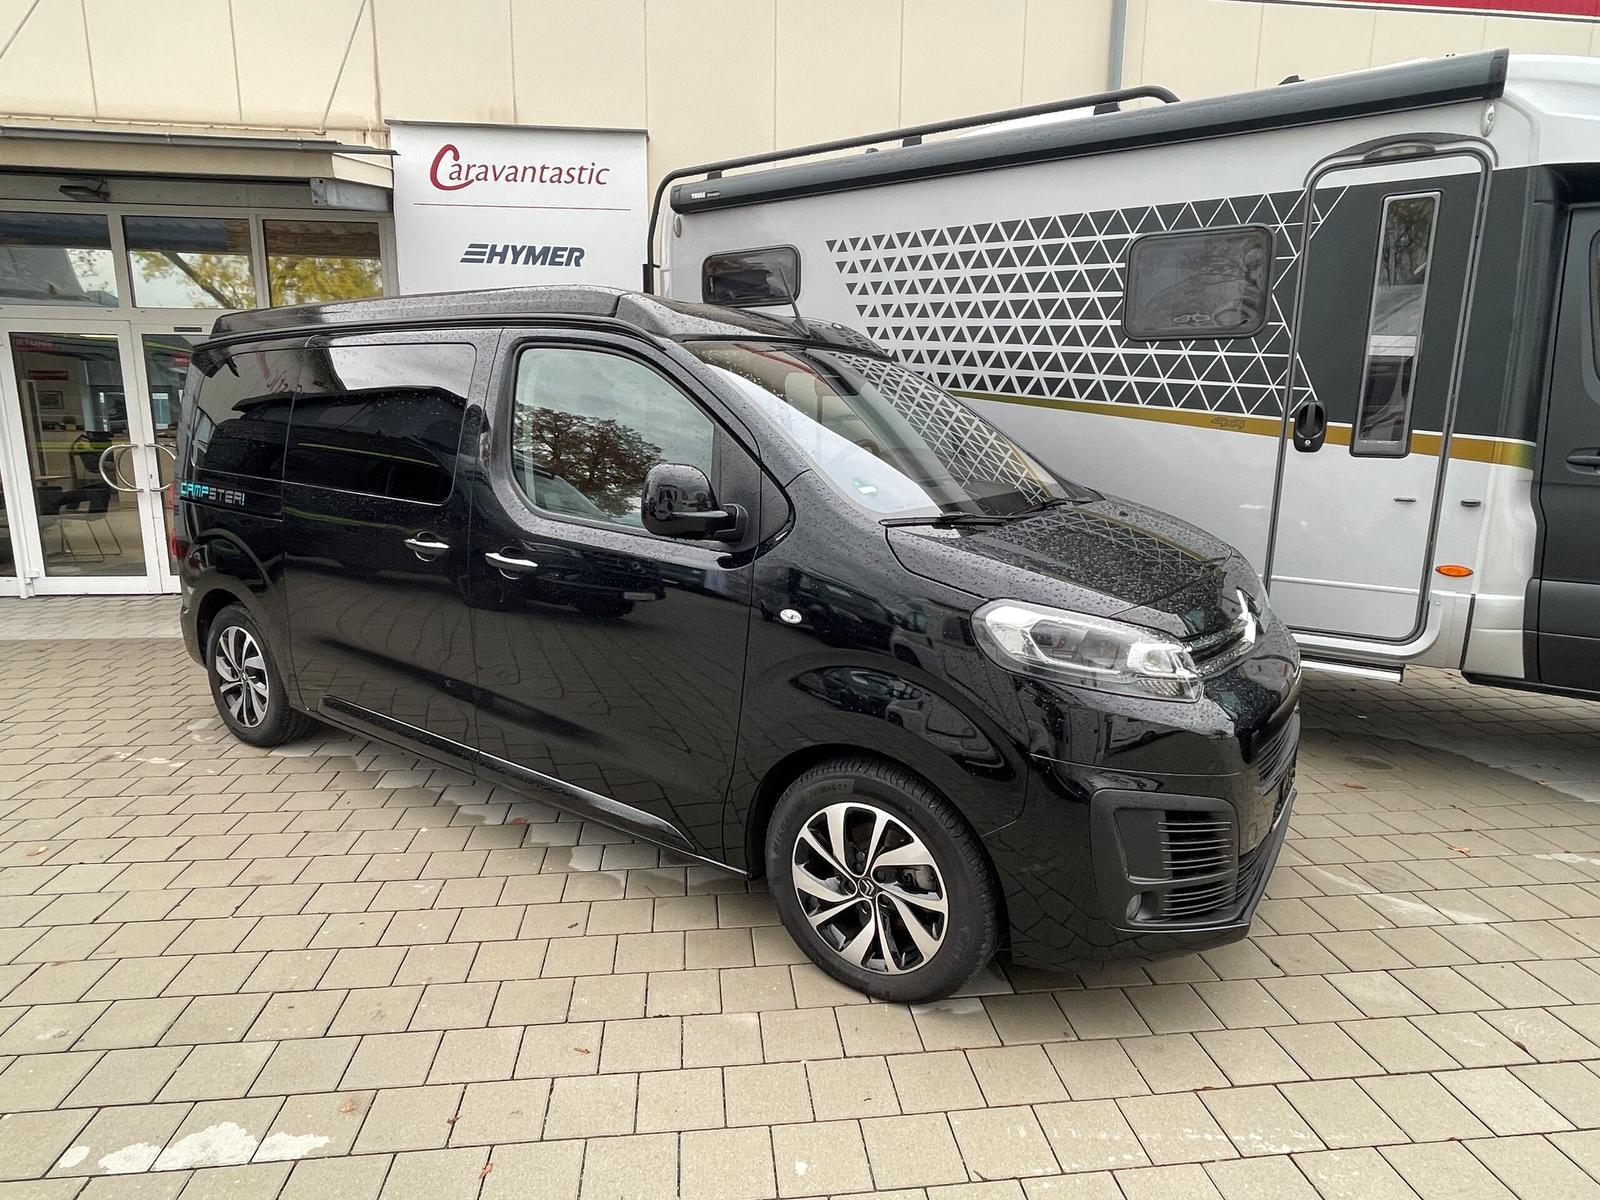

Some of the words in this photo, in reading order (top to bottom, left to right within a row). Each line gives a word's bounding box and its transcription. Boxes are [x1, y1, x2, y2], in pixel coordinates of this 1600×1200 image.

[430, 143, 611, 191] Caravantastic
[484, 243, 586, 268] HYMER
[181, 482, 246, 506] CAMPSTER!
